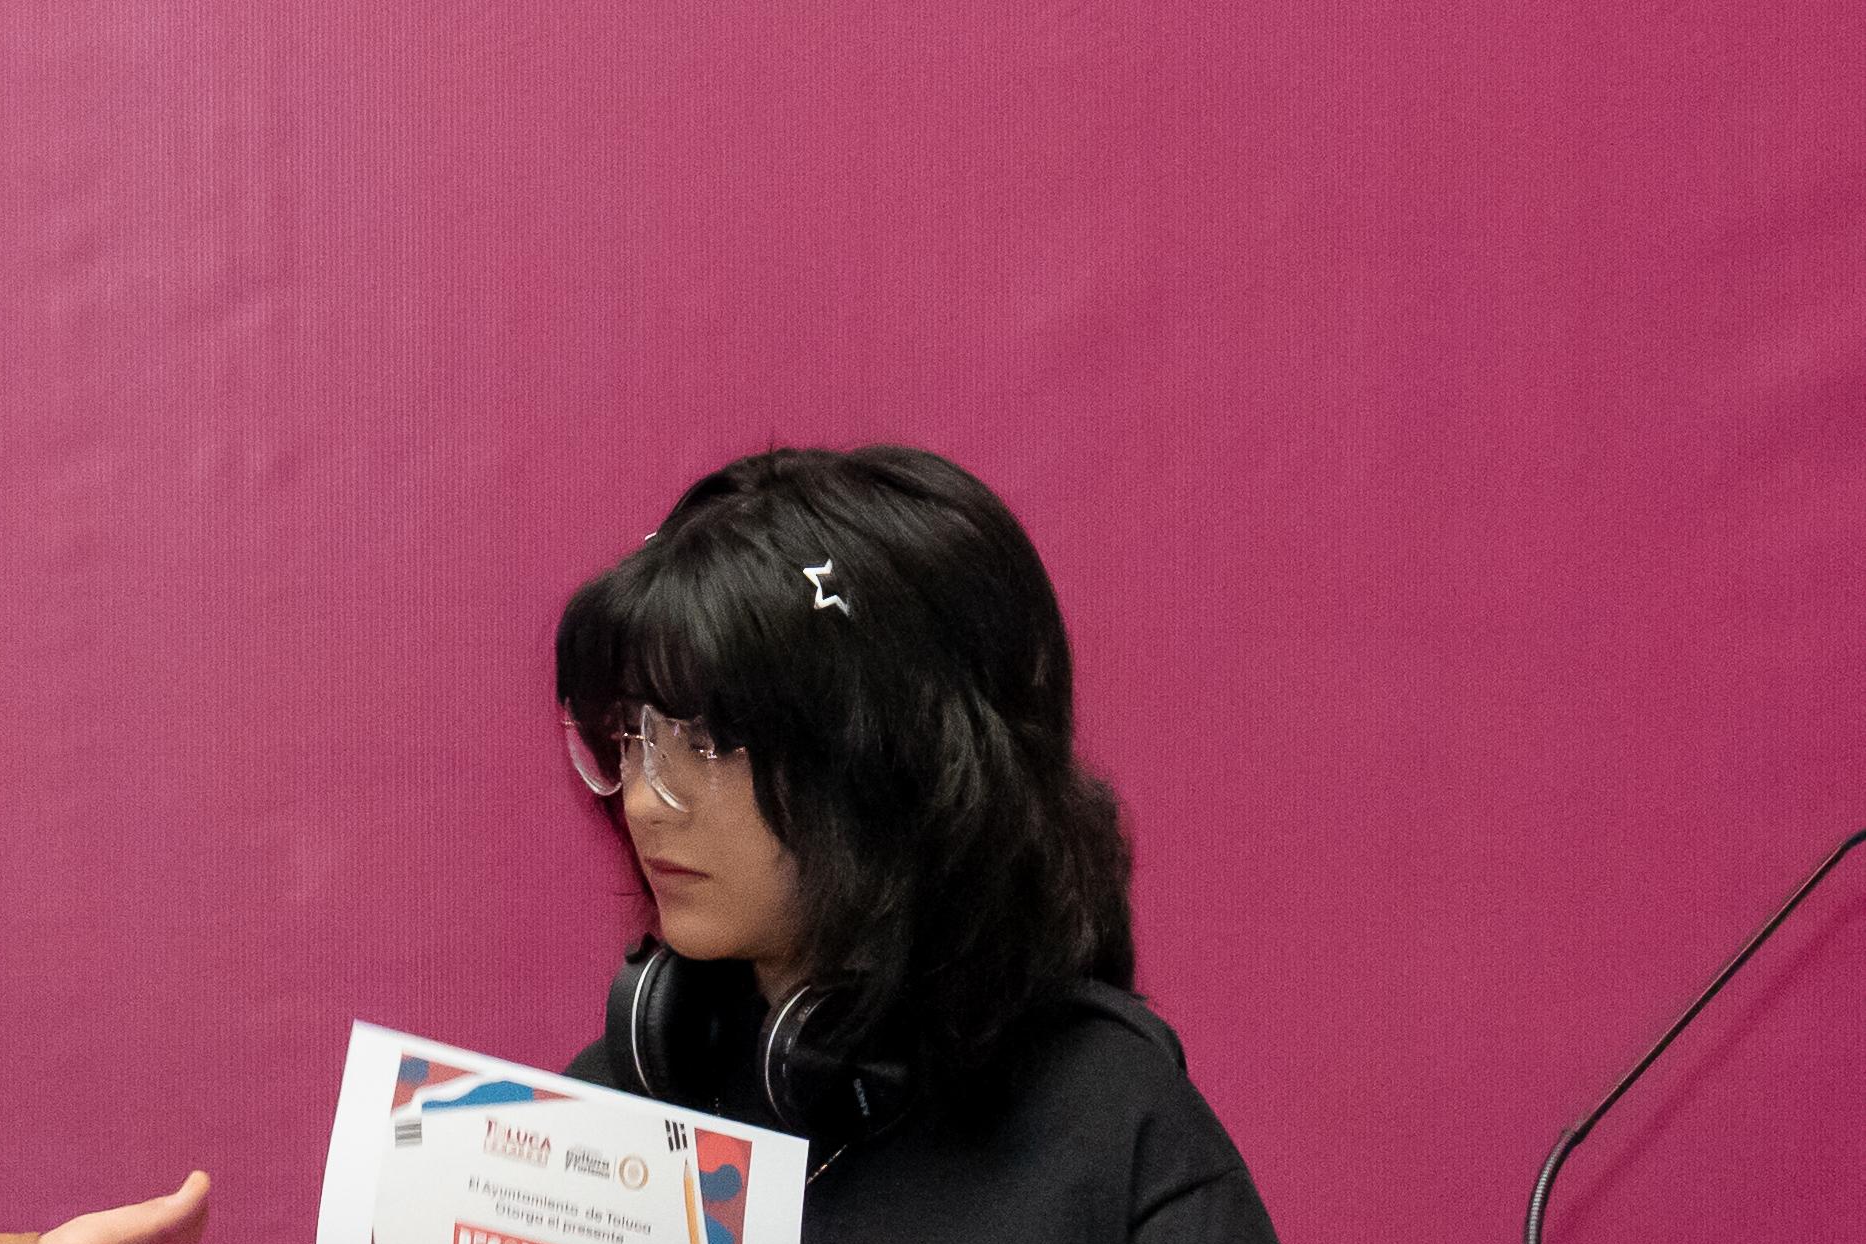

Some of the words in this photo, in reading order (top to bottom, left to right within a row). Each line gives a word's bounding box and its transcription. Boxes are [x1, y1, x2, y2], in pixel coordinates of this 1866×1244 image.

[853, 1078, 870, 1118] SONY
[483, 1178, 579, 1217] Ayuntamiento
[585, 1205, 604, 1225] de
[607, 1212, 652, 1236] Toluca
